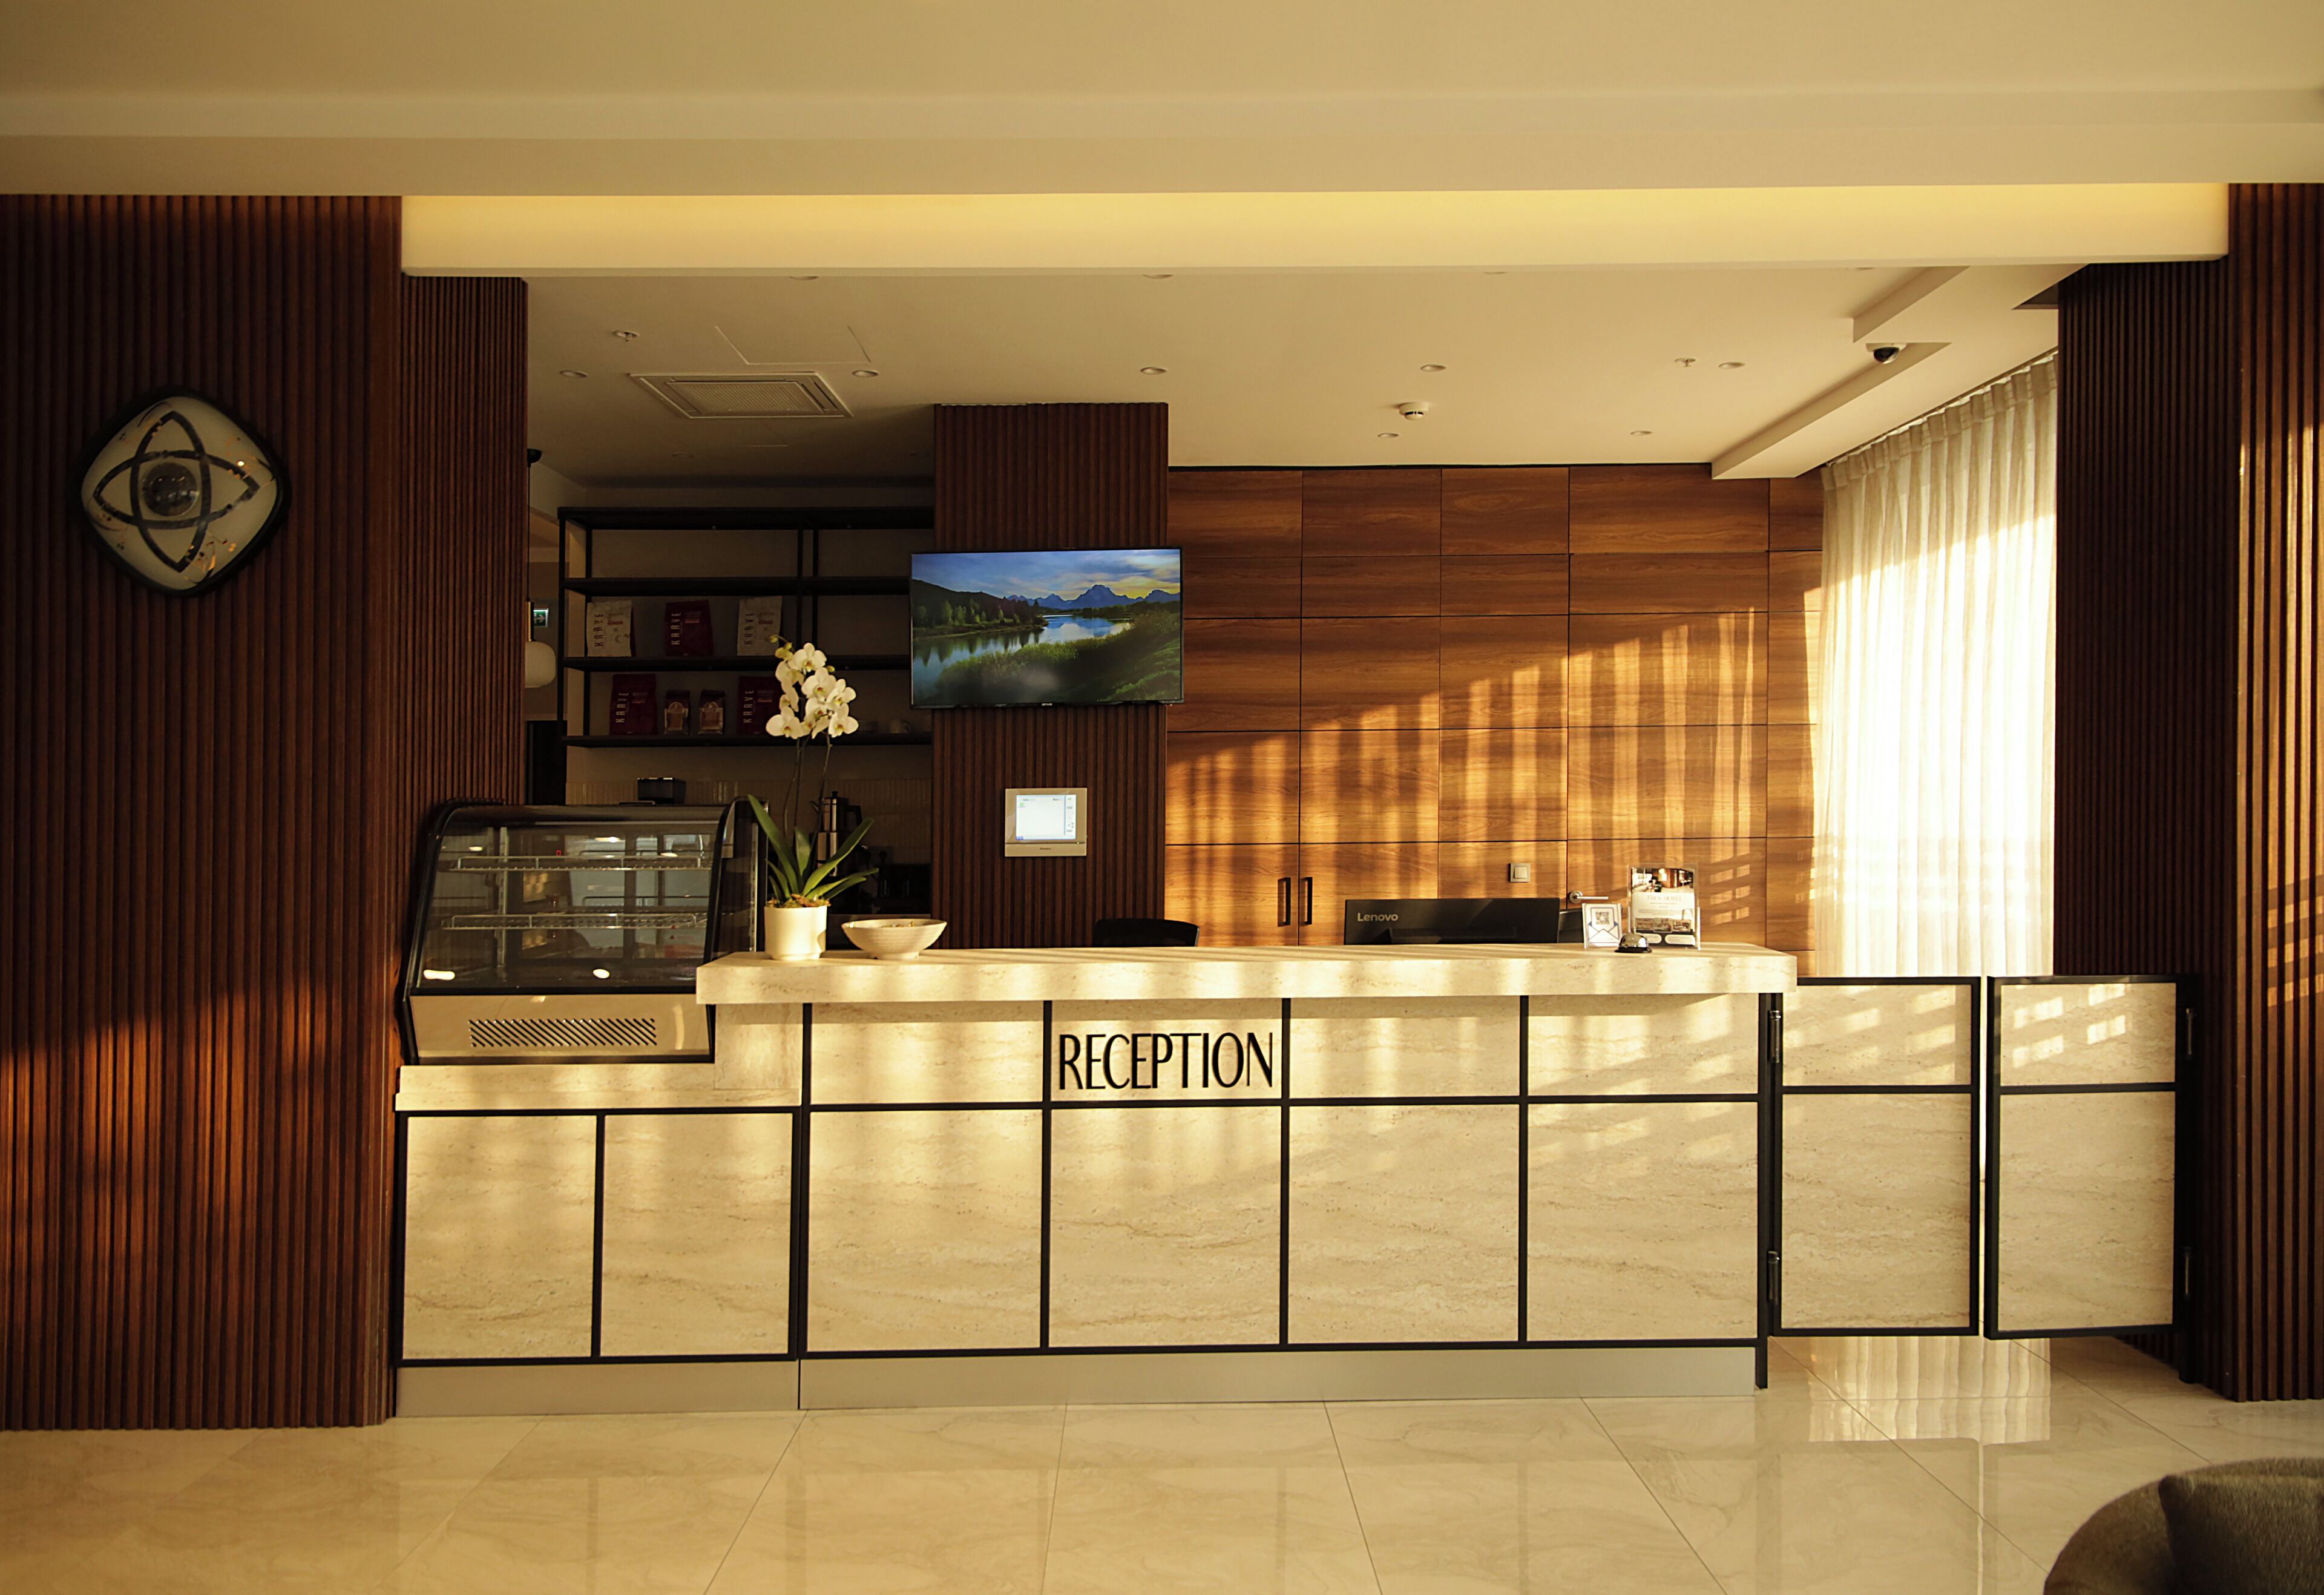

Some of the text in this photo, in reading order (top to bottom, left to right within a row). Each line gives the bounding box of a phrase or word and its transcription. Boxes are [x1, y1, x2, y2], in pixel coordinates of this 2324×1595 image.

[671, 612, 681, 645] KARVE
[743, 689, 754, 723] KARVE
[1357, 912, 1399, 922] Lenovo
[1059, 1032, 1273, 1090] RECEPTION
